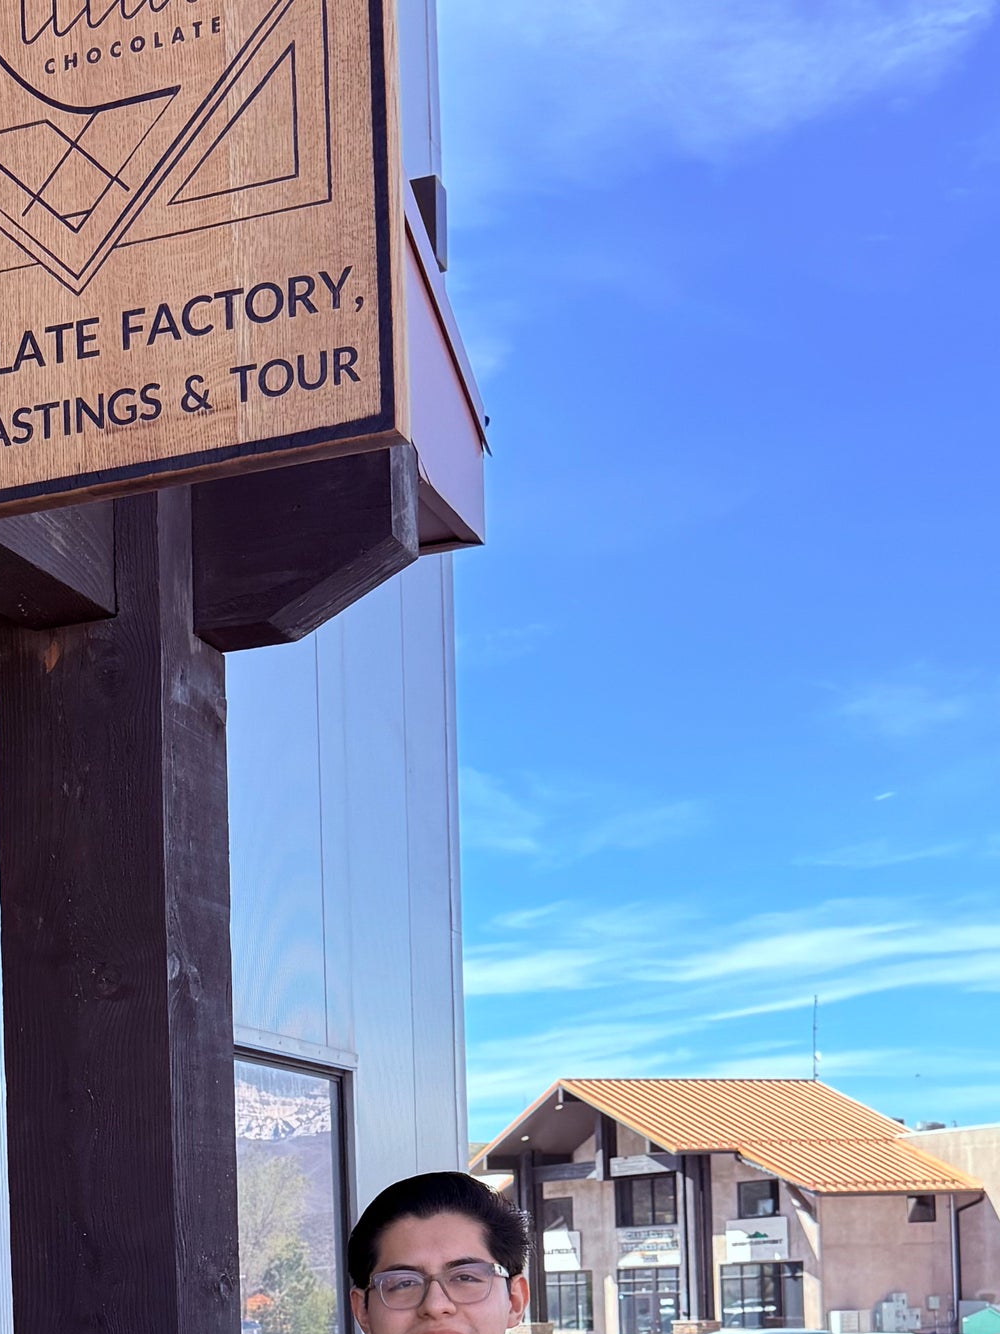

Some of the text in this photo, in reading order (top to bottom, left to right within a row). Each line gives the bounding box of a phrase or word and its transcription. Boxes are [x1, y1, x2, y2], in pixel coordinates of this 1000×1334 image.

[43, 15, 222, 75] CHOCOLATE
[121, 265, 365, 351] FACTORY,
[179, 374, 213, 413] &
[229, 346, 361, 403] TOUR
